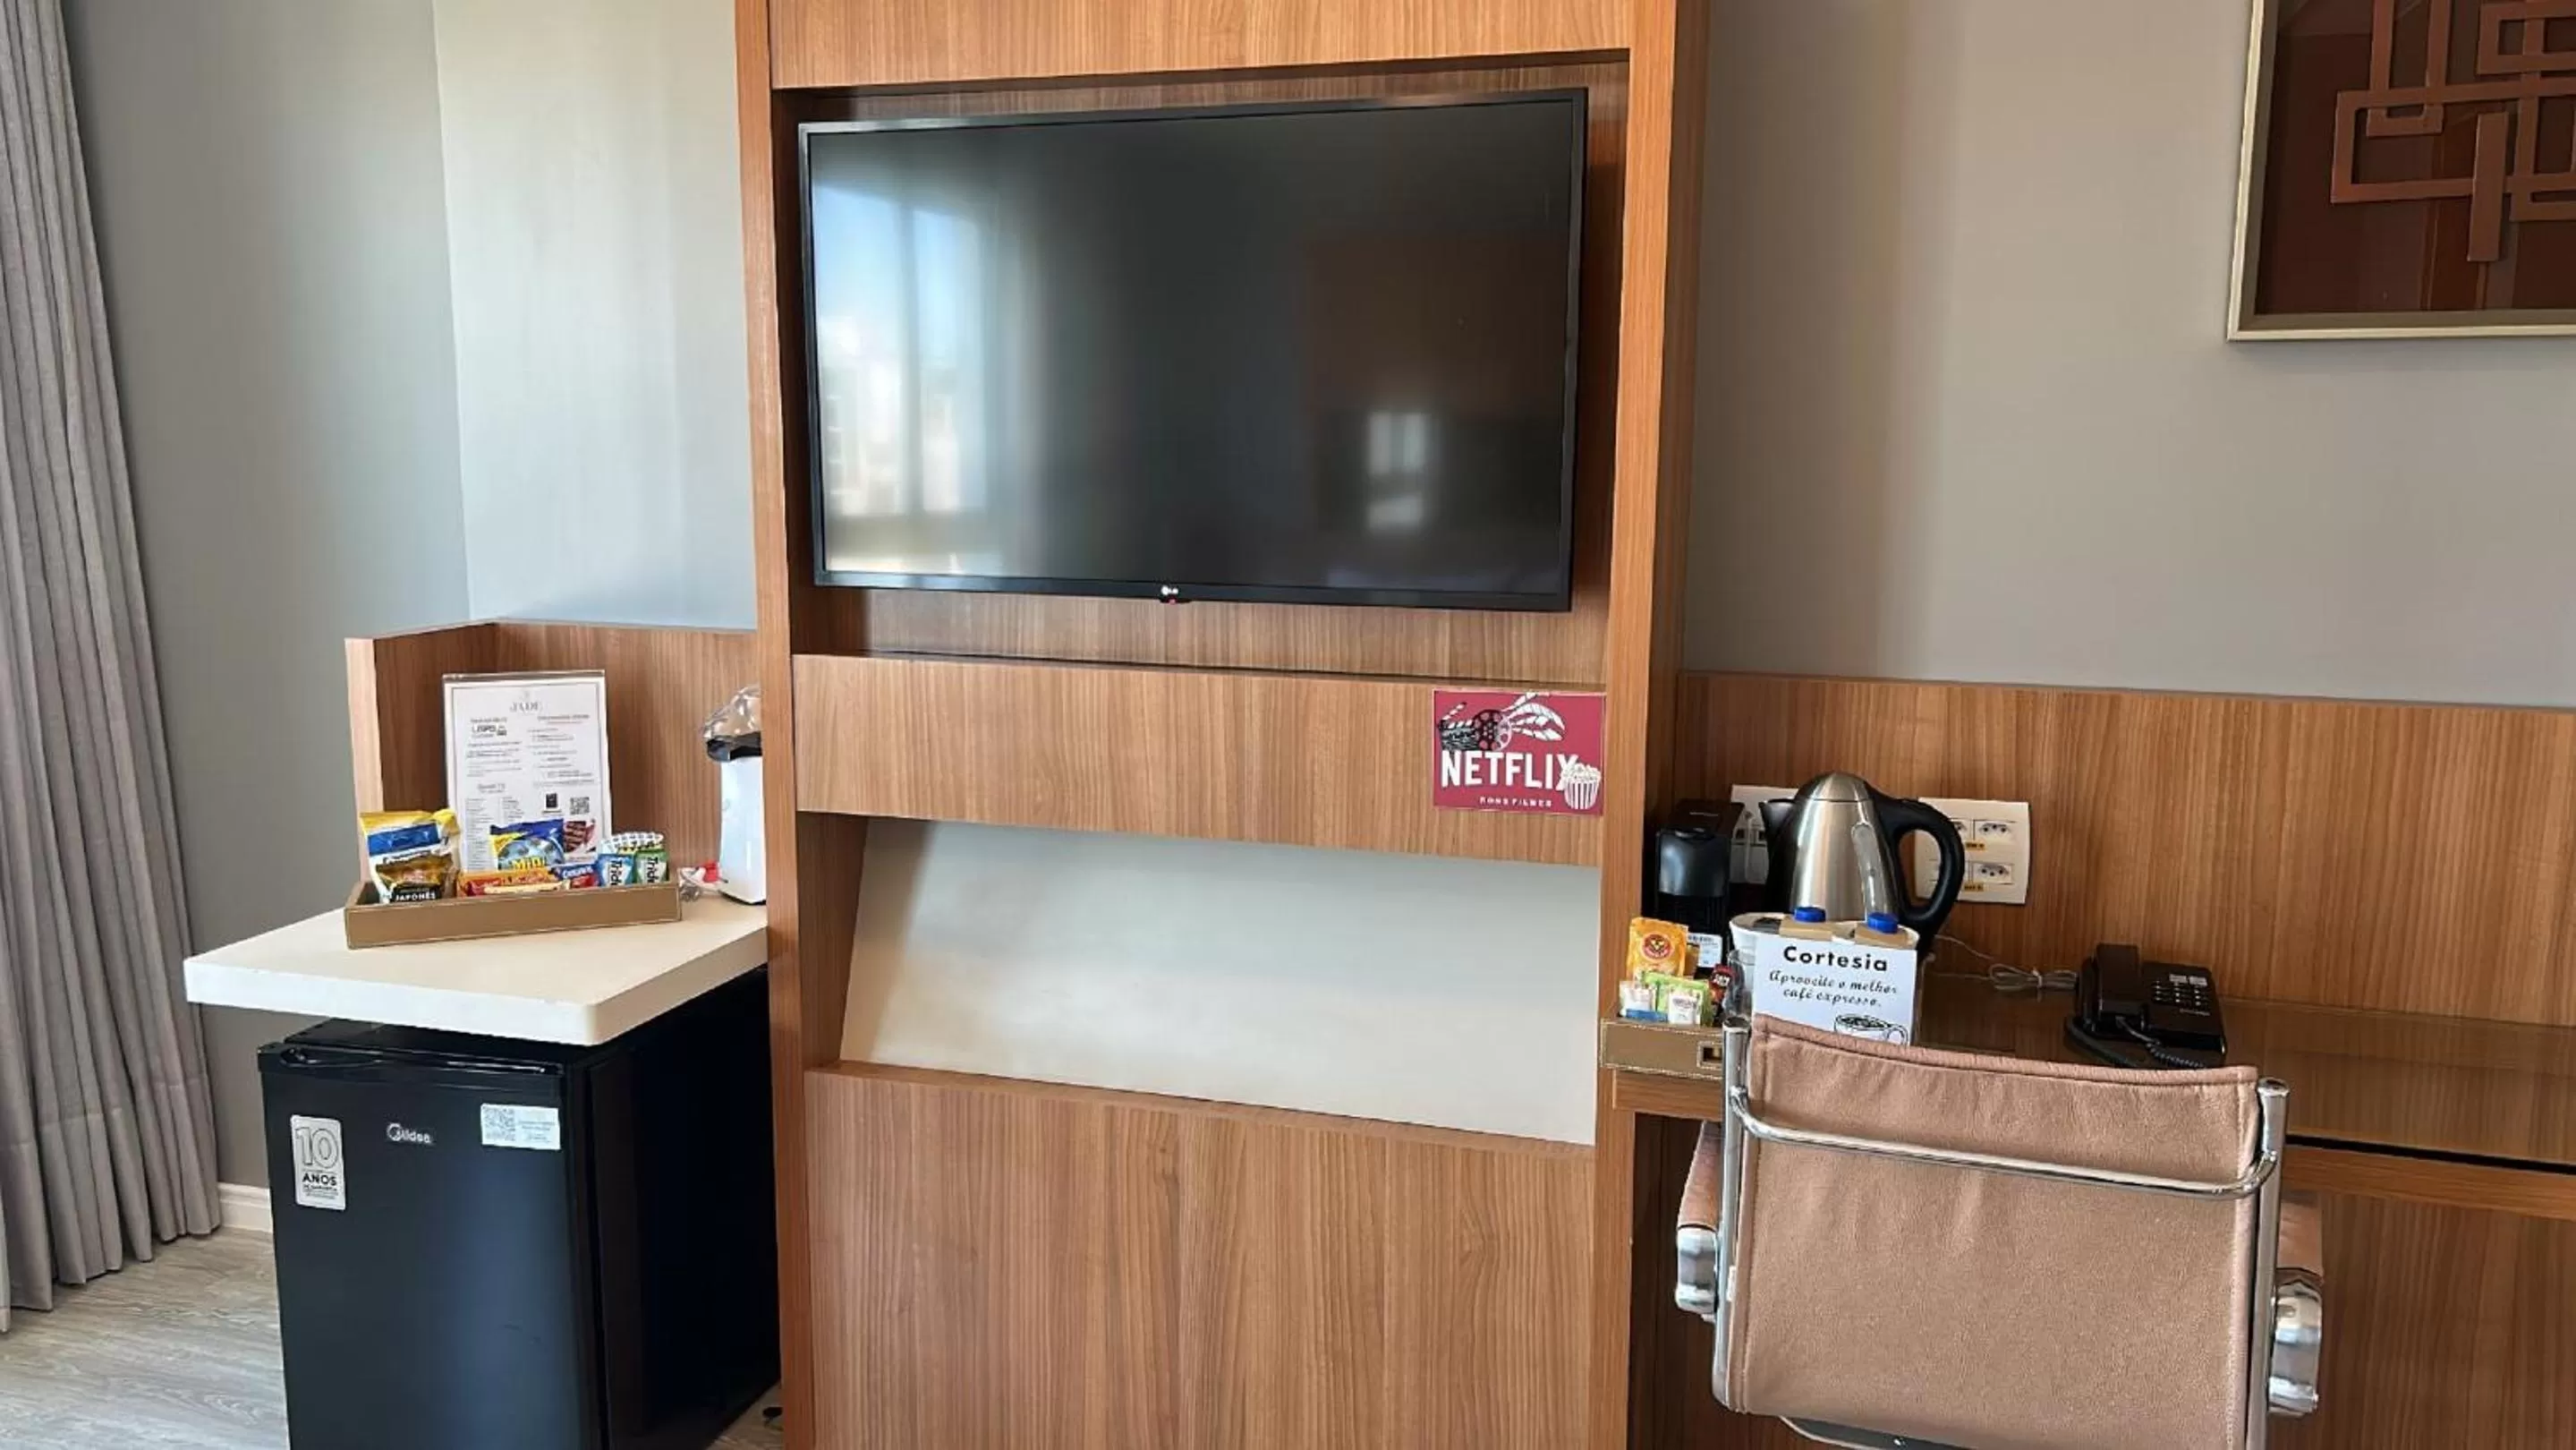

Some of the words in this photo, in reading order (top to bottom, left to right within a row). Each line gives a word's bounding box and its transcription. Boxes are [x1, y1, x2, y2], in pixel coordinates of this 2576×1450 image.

[1441, 750, 1579, 791] NETFLIX
[1783, 945, 1888, 972] Cortesia
[1783, 986, 1814, 1002] café
[294, 1126, 339, 1170] 10
[302, 1173, 337, 1187] ANOS
